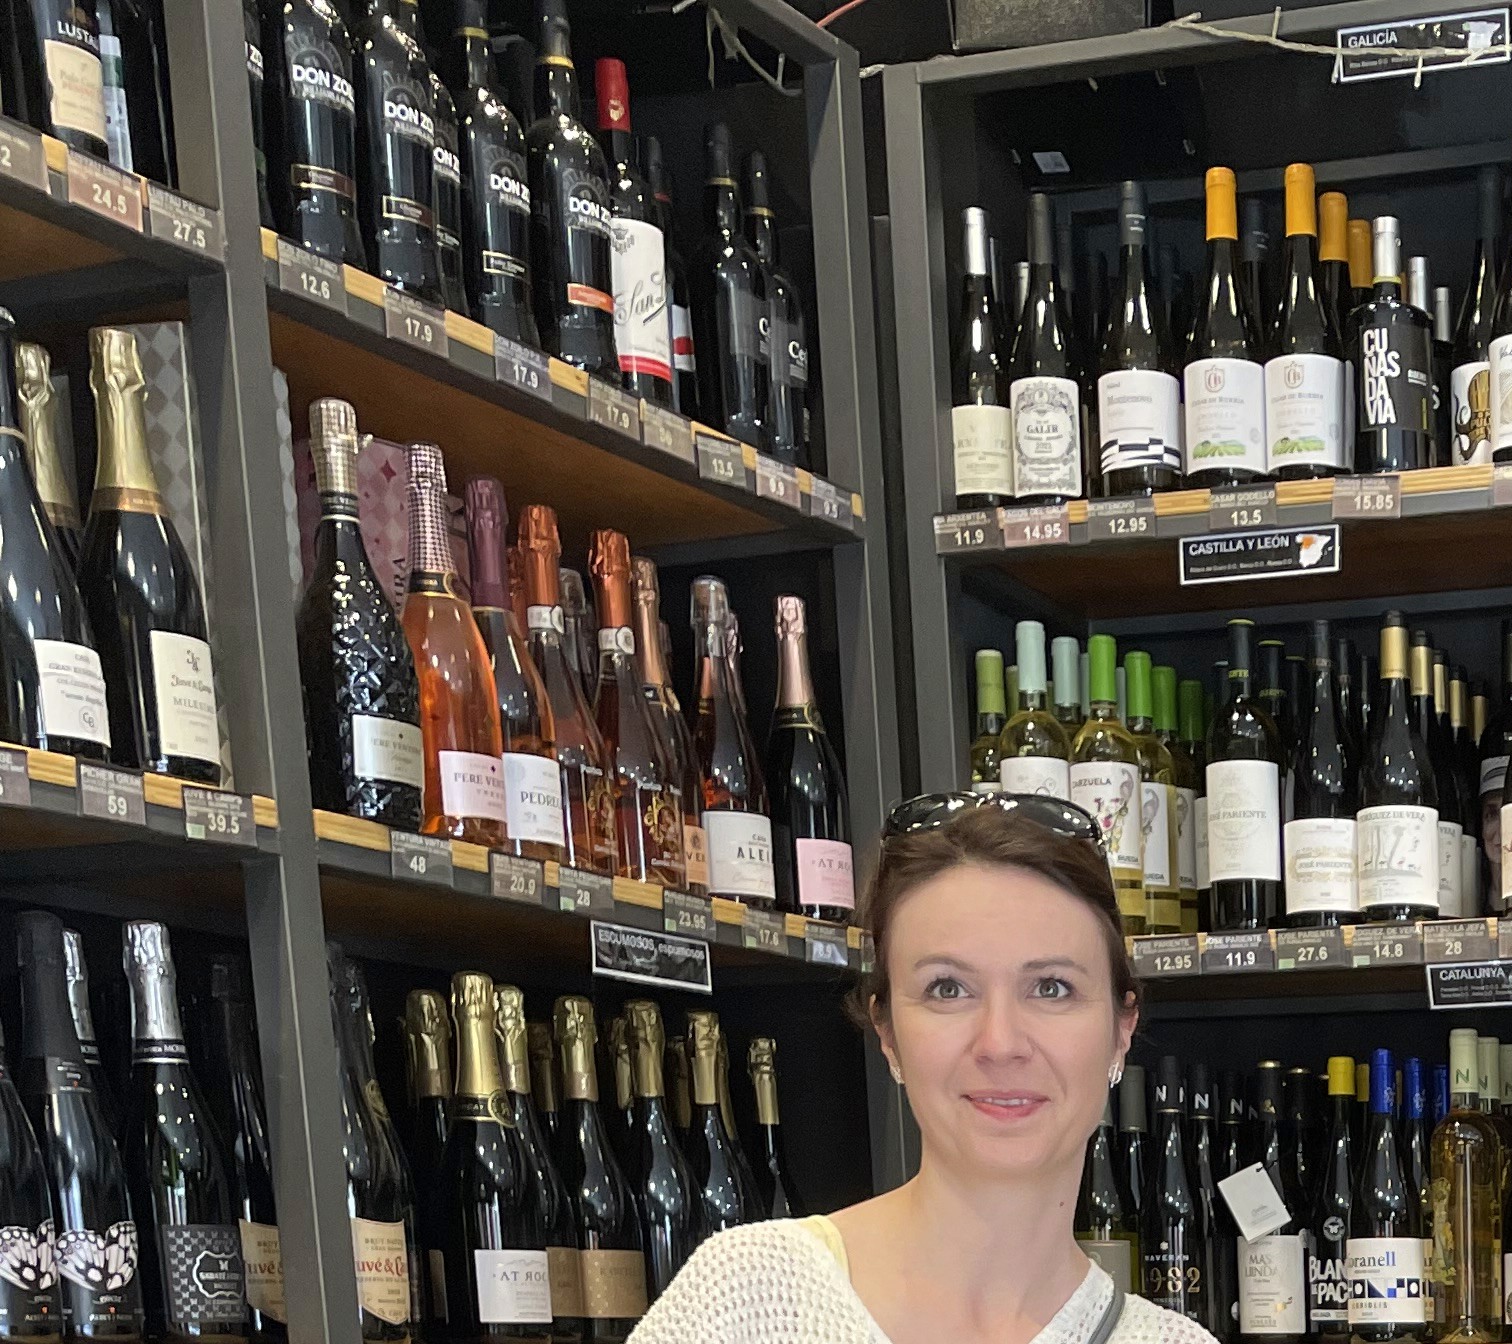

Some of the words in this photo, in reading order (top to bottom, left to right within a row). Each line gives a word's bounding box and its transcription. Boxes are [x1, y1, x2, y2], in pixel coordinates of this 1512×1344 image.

[292, 64, 331, 87] DON
[383, 100, 418, 125] DON
[490, 172, 522, 194] DON
[91, 183, 128, 216] 24.5
[569, 196, 596, 216] DON
[172, 219, 206, 248] 27.5
[300, 273, 331, 299] 12.6
[404, 316, 433, 343] 17.9
[1363, 327, 1388, 355] CU
[512, 363, 539, 388] 17.9
[1364, 376, 1389, 402] DA
[606, 404, 630, 429] 17.9
[1366, 398, 1396, 426] VIA
[712, 458, 734, 477] 13.5
[1354, 493, 1393, 510] 15.85
[1109, 516, 1147, 534] 12.95
[1230, 509, 1261, 526] 13.5
[954, 528, 984, 545] 11.9
[1023, 522, 1062, 541] 14.95
[1189, 541, 1243, 556] CASTILLA
[1246, 539, 1255, 551] Y
[1257, 533, 1290, 551] LEÓN
[108, 796, 127, 815] 59
[207, 812, 239, 834] 39.5
[410, 855, 426, 873] 48
[510, 875, 535, 896] 20.9
[577, 888, 591, 905] 28
[1297, 946, 1328, 963] 27.6
[1373, 942, 1403, 959] 14.8
[1445, 941, 1463, 956] 28
[1154, 954, 1192, 970] 12.95
[1226, 951, 1256, 967] 11.9
[1439, 966, 1506, 982] CATALUNYA
[1455, 1067, 1470, 1084] N
[1195, 1093, 1209, 1110] N
